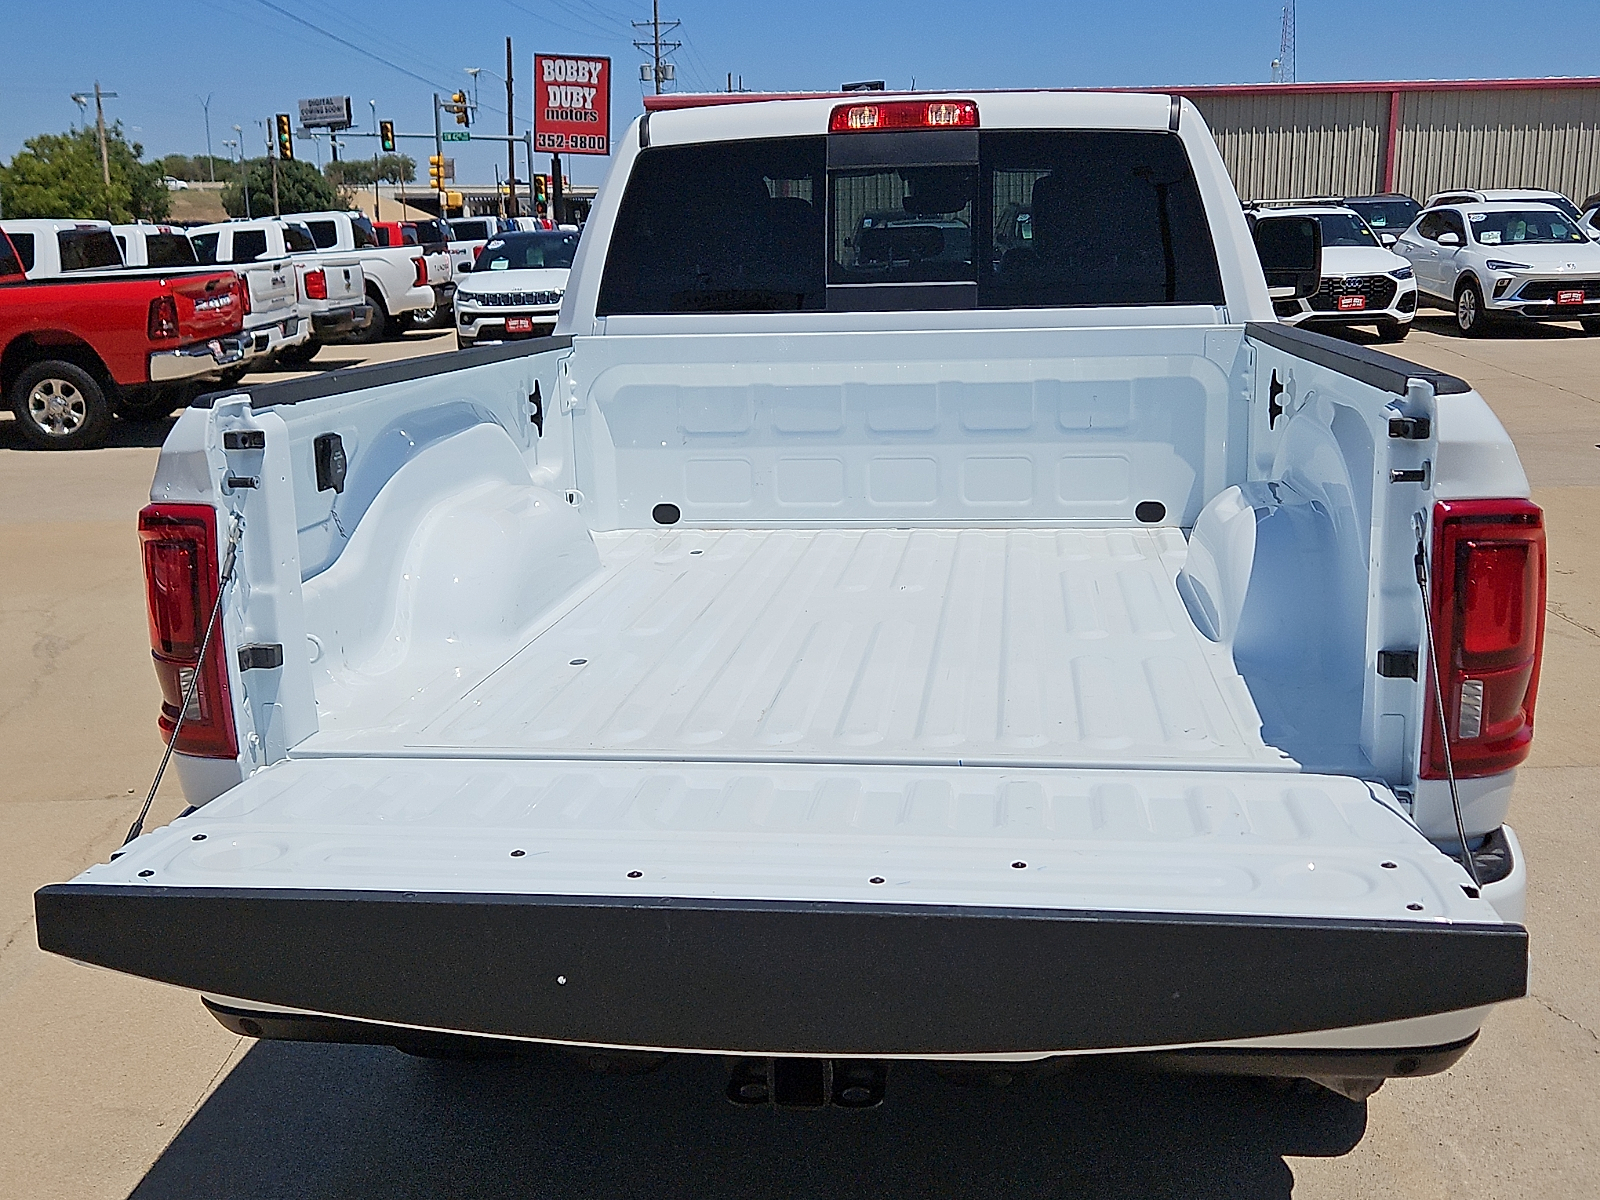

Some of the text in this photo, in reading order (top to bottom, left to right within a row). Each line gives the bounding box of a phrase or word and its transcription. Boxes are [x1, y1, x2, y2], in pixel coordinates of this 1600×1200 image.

[541, 59, 602, 84] BOBBY
[308, 97, 334, 107] DIGITAL
[547, 85, 597, 110] DUBY
[546, 108, 598, 122] motors
[537, 133, 605, 150] 352-9800
